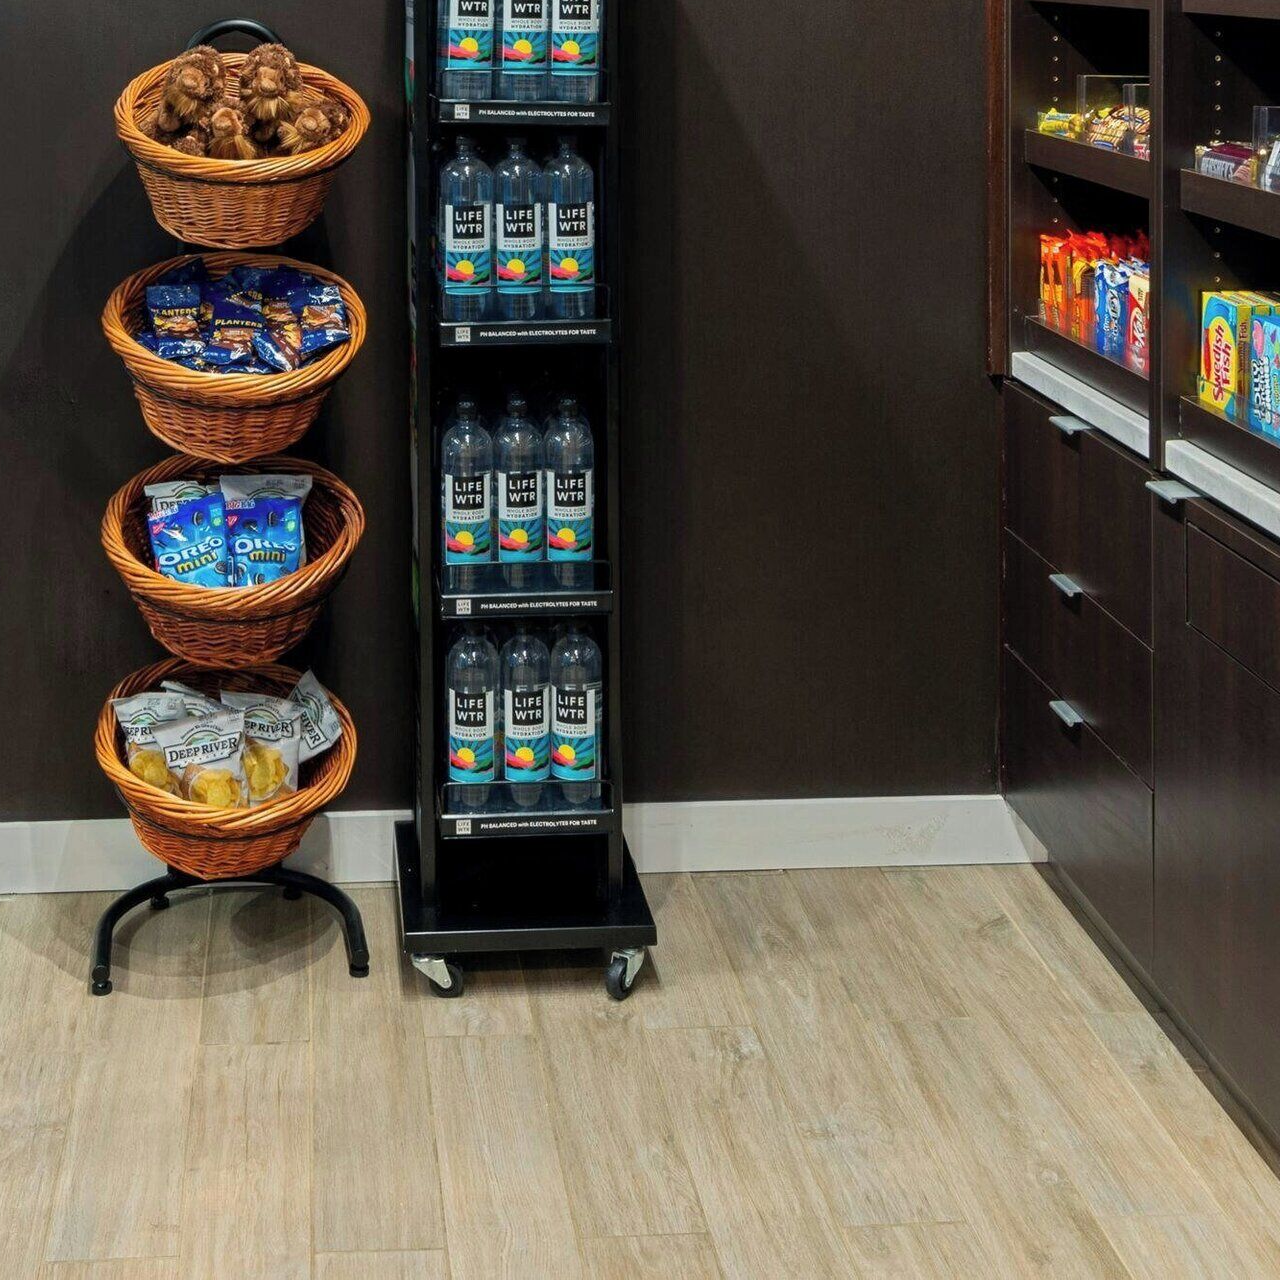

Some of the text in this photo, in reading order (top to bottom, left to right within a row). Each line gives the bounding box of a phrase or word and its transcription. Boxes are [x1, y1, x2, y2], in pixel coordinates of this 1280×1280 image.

[460, 1, 488, 12] WTR
[513, 2, 542, 13] WTR
[561, 3, 589, 14] WTR
[455, 210, 483, 221] LIFE
[506, 209, 533, 220] LIFE
[559, 208, 586, 219] LIFE
[455, 223, 483, 234] WTR
[506, 222, 533, 233] WTR
[559, 221, 586, 232] WTR
[215, 318, 263, 329] PLANTERS
[1239, 319, 1248, 340] Fish
[1212, 324, 1226, 402] Swedish
[1221, 343, 1233, 388] Fish
[455, 481, 483, 492] LIFE
[509, 479, 536, 490] LIFE
[455, 494, 482, 505] WTR
[158, 536, 224, 566] OREO
[233, 538, 297, 554] OREO
[249, 549, 286, 563] mini
[176, 550, 218, 574] mini
[257, 721, 290, 734] RIVER
[300, 710, 322, 744] RIVER
[168, 736, 239, 762] DEEP RIVER
